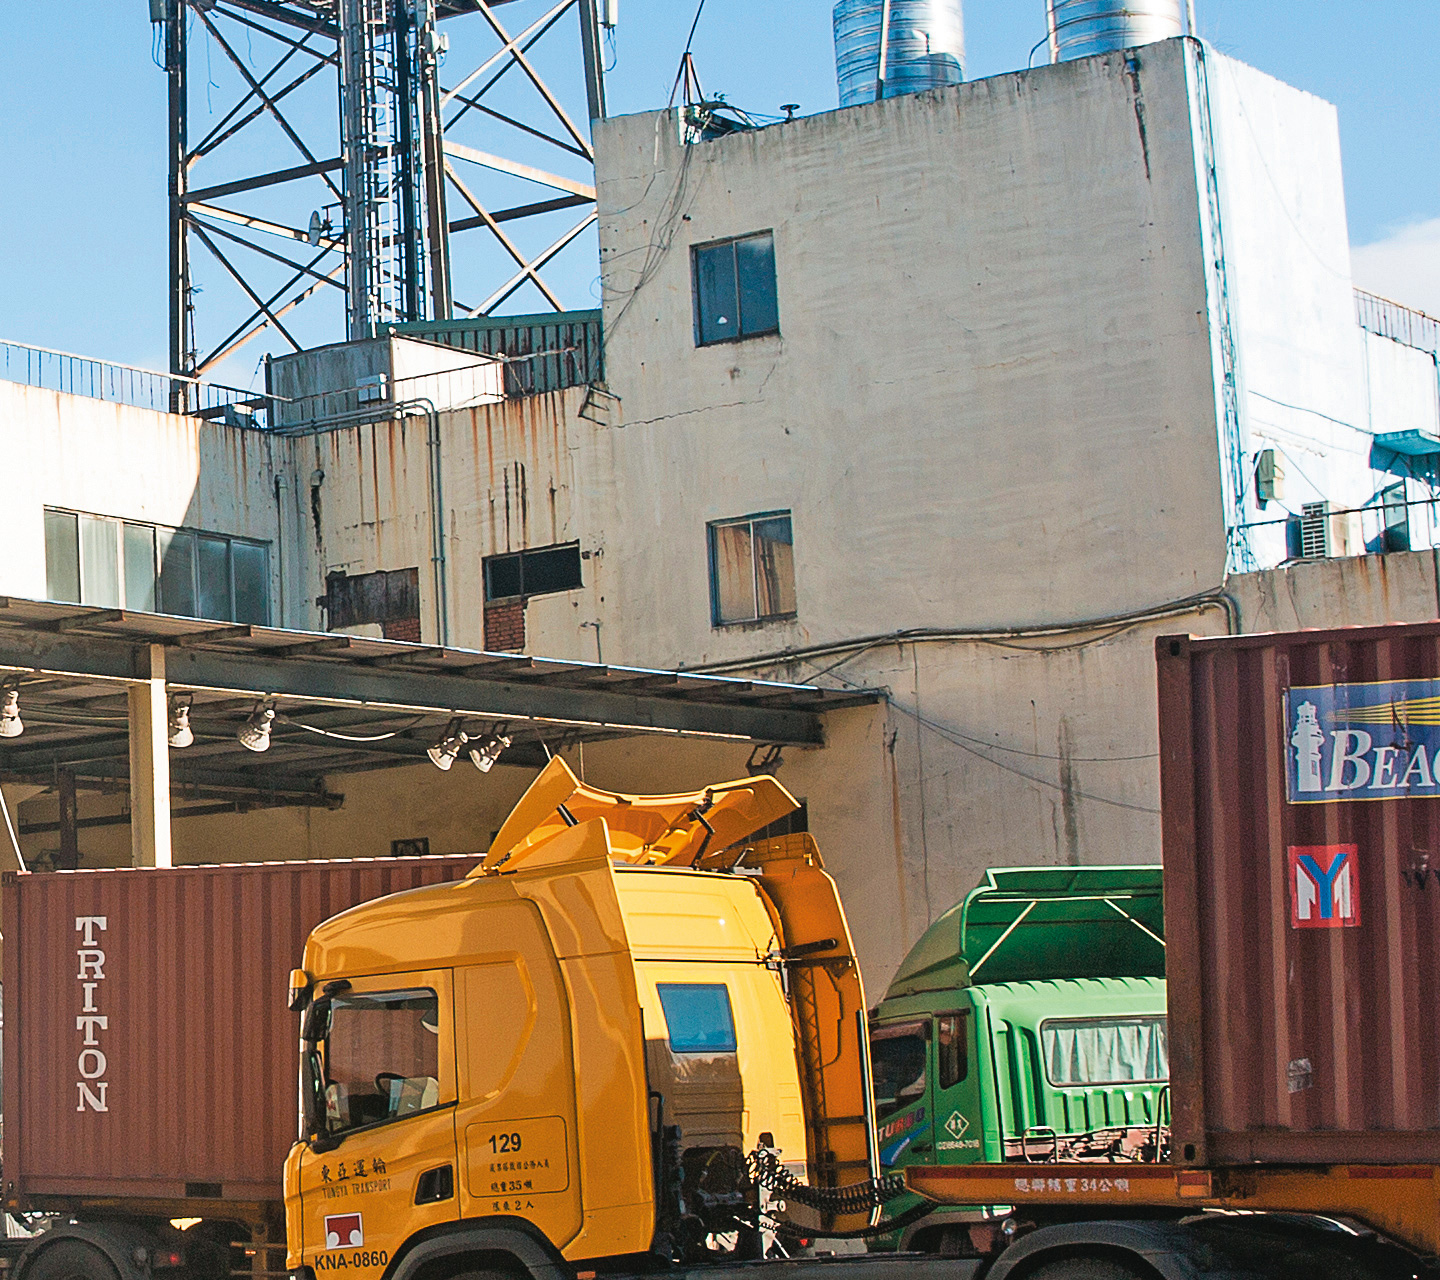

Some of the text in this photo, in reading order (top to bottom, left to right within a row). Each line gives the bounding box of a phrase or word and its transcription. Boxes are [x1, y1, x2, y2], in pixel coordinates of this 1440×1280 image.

[75, 916, 109, 1112] TRITON
[878, 1106, 925, 1142] TURBO
[488, 1132, 522, 1154] 129
[315, 1250, 388, 1270] KNA-0860
